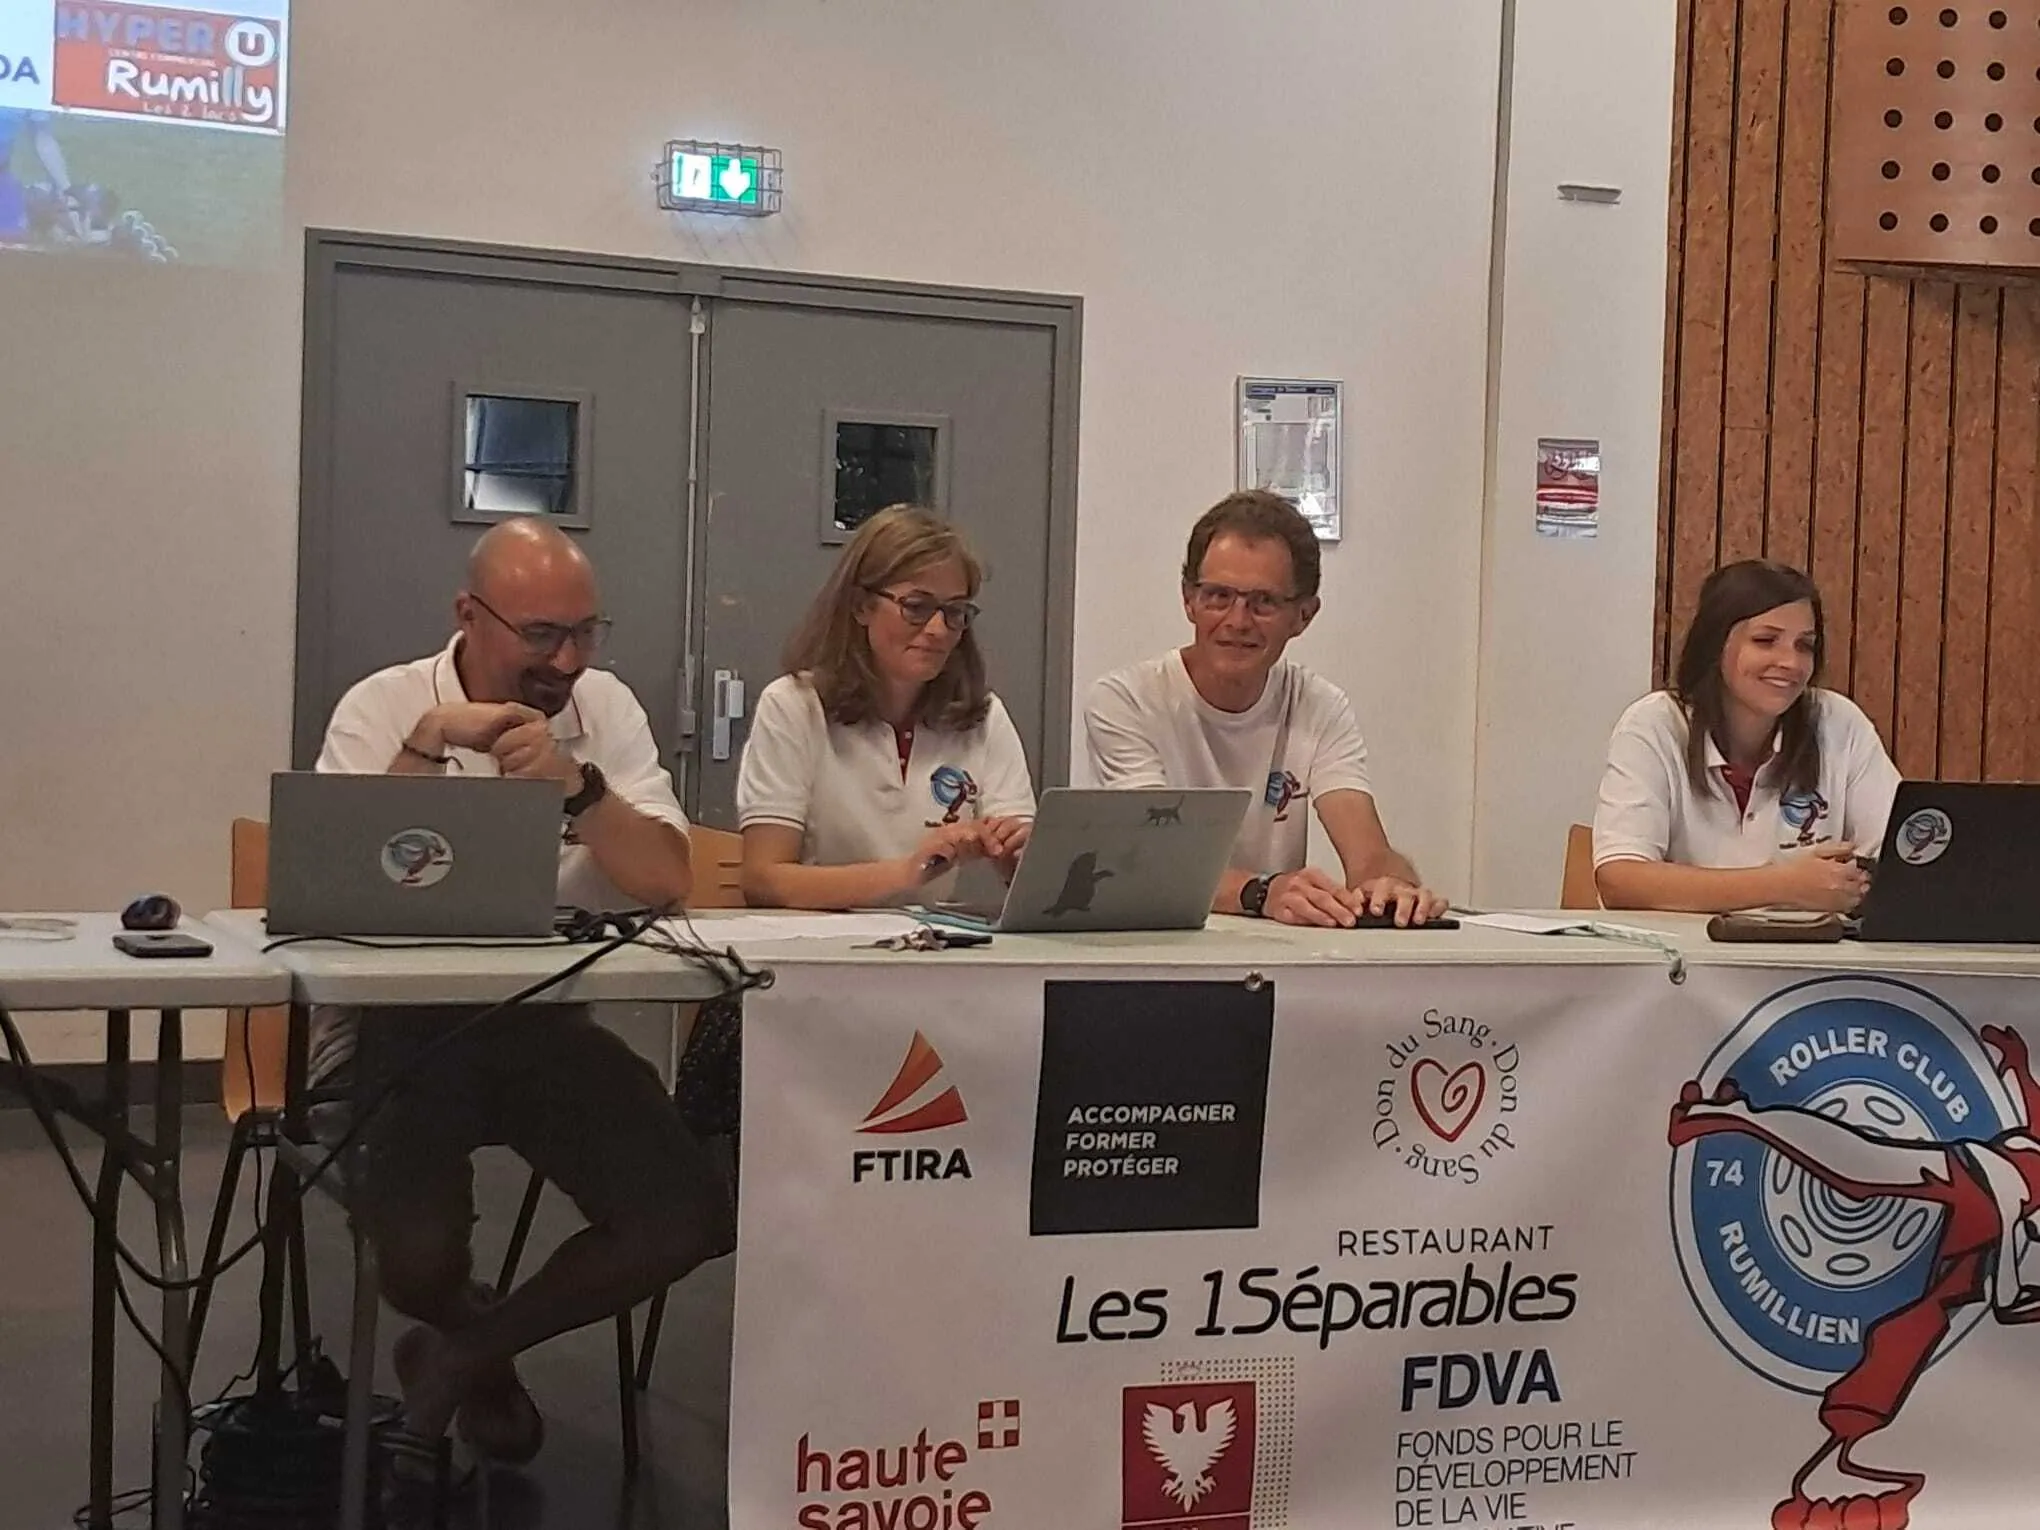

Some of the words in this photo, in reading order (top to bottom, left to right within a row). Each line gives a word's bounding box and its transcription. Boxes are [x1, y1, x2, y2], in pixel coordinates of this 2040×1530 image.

[57, 7, 215, 54] HYPER
[107, 58, 273, 123] Rumilly
[1386, 1034, 1420, 1069] du
[1493, 1043, 1520, 1112] Don
[1769, 1027, 1889, 1087] ROLLER
[1897, 1043, 1970, 1123] CLUB
[1067, 1104, 1236, 1125] ACCOMPAGNER
[1373, 1079, 1401, 1149] Don
[1065, 1131, 1157, 1151] FORMER
[1480, 1122, 1516, 1158] du
[853, 1148, 972, 1183] FTIRA
[1063, 1154, 1179, 1178] PROTÉGER
[1706, 1160, 1745, 1187] 74
[1338, 1226, 1554, 1256] RESTAURANT
[1719, 1221, 1860, 1345] RUMILLIEN
[1056, 1275, 1168, 1343] Les
[1195, 1262, 1578, 1349] 1Séparables
[1401, 1349, 1562, 1411] FDVA
[797, 1427, 968, 1493] haute
[1397, 1428, 1494, 1459] FONDS
[1503, 1423, 1581, 1452] POUR
[1591, 1420, 1623, 1447] LE
[1395, 1449, 1638, 1493] DÉVELOPPEMENT
[798, 1489, 992, 1530] savoie
[1395, 1498, 1433, 1527] DE
[1442, 1496, 1478, 1525] LA
[1484, 1492, 1527, 1521] VIE
